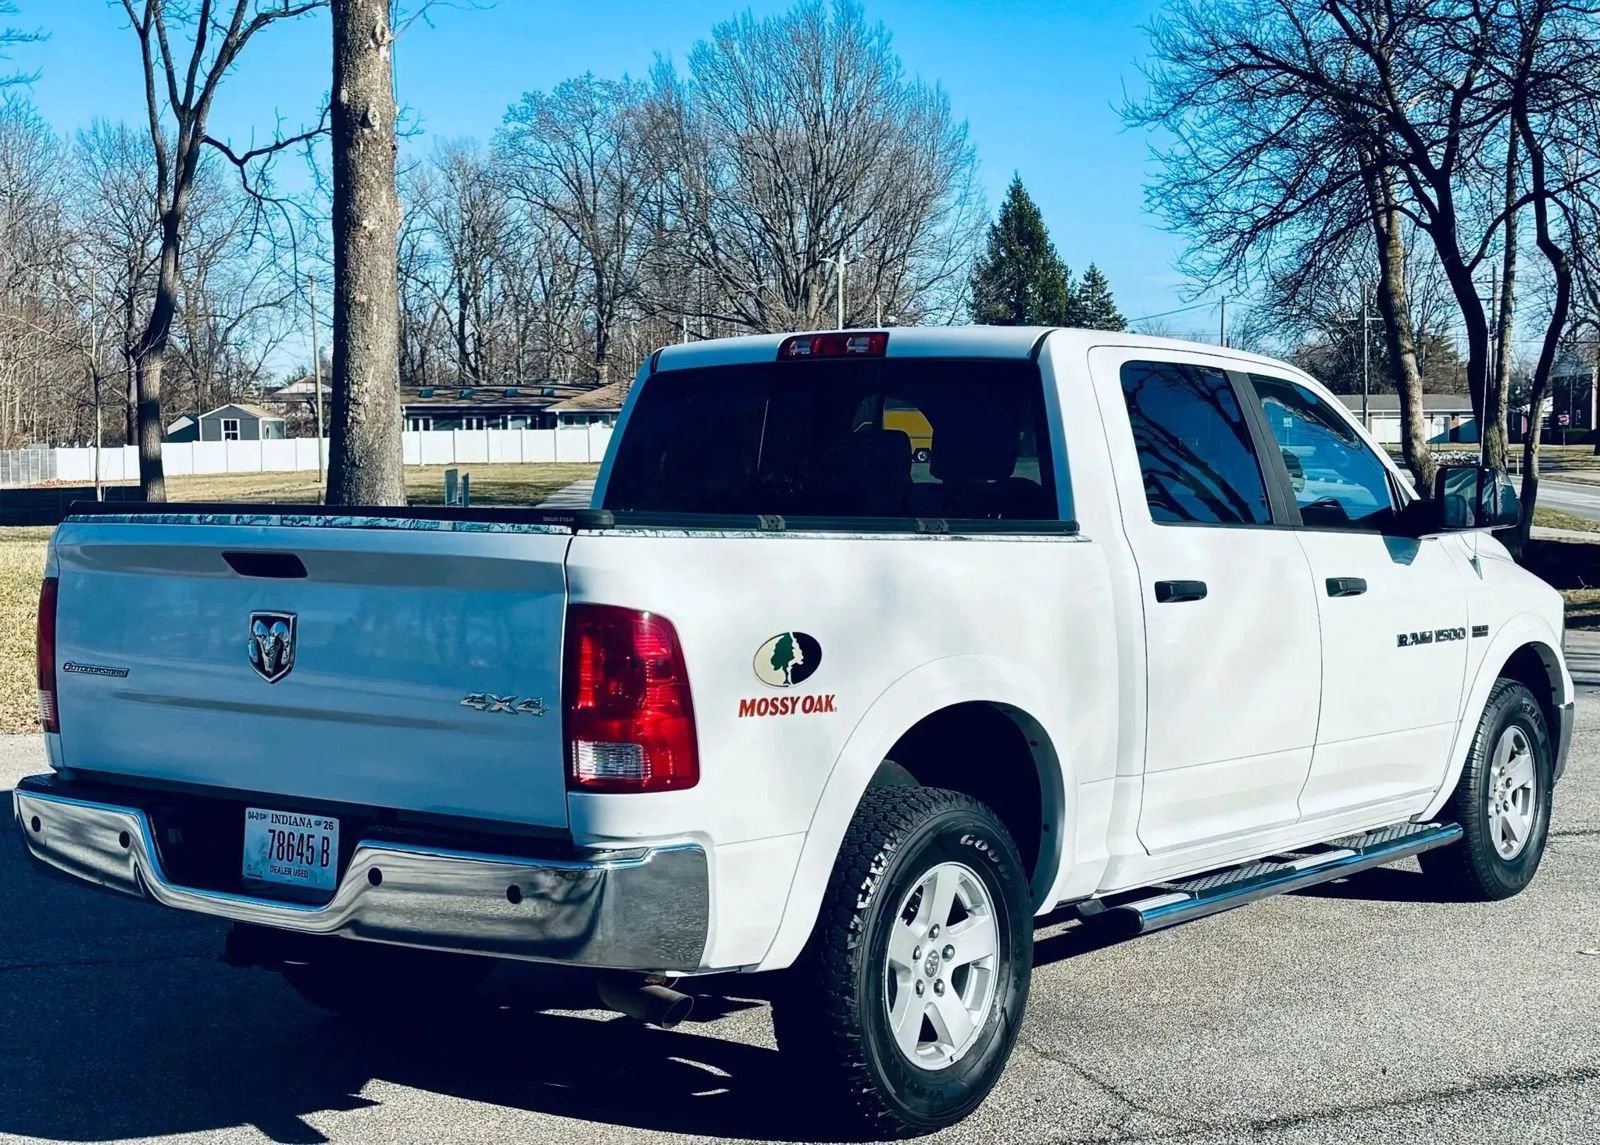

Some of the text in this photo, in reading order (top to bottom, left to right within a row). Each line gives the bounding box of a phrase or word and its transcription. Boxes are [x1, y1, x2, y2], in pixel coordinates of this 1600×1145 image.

[1397, 631, 1433, 647] RAM
[1434, 627, 1466, 643] 1500
[738, 696, 800, 718] MOSSY
[271, 813, 313, 828] INDIANA
[323, 821, 334, 831] 26
[268, 829, 330, 868] 78645 B
[269, 864, 293, 876] DEALER
[293, 868, 309, 878] USED
